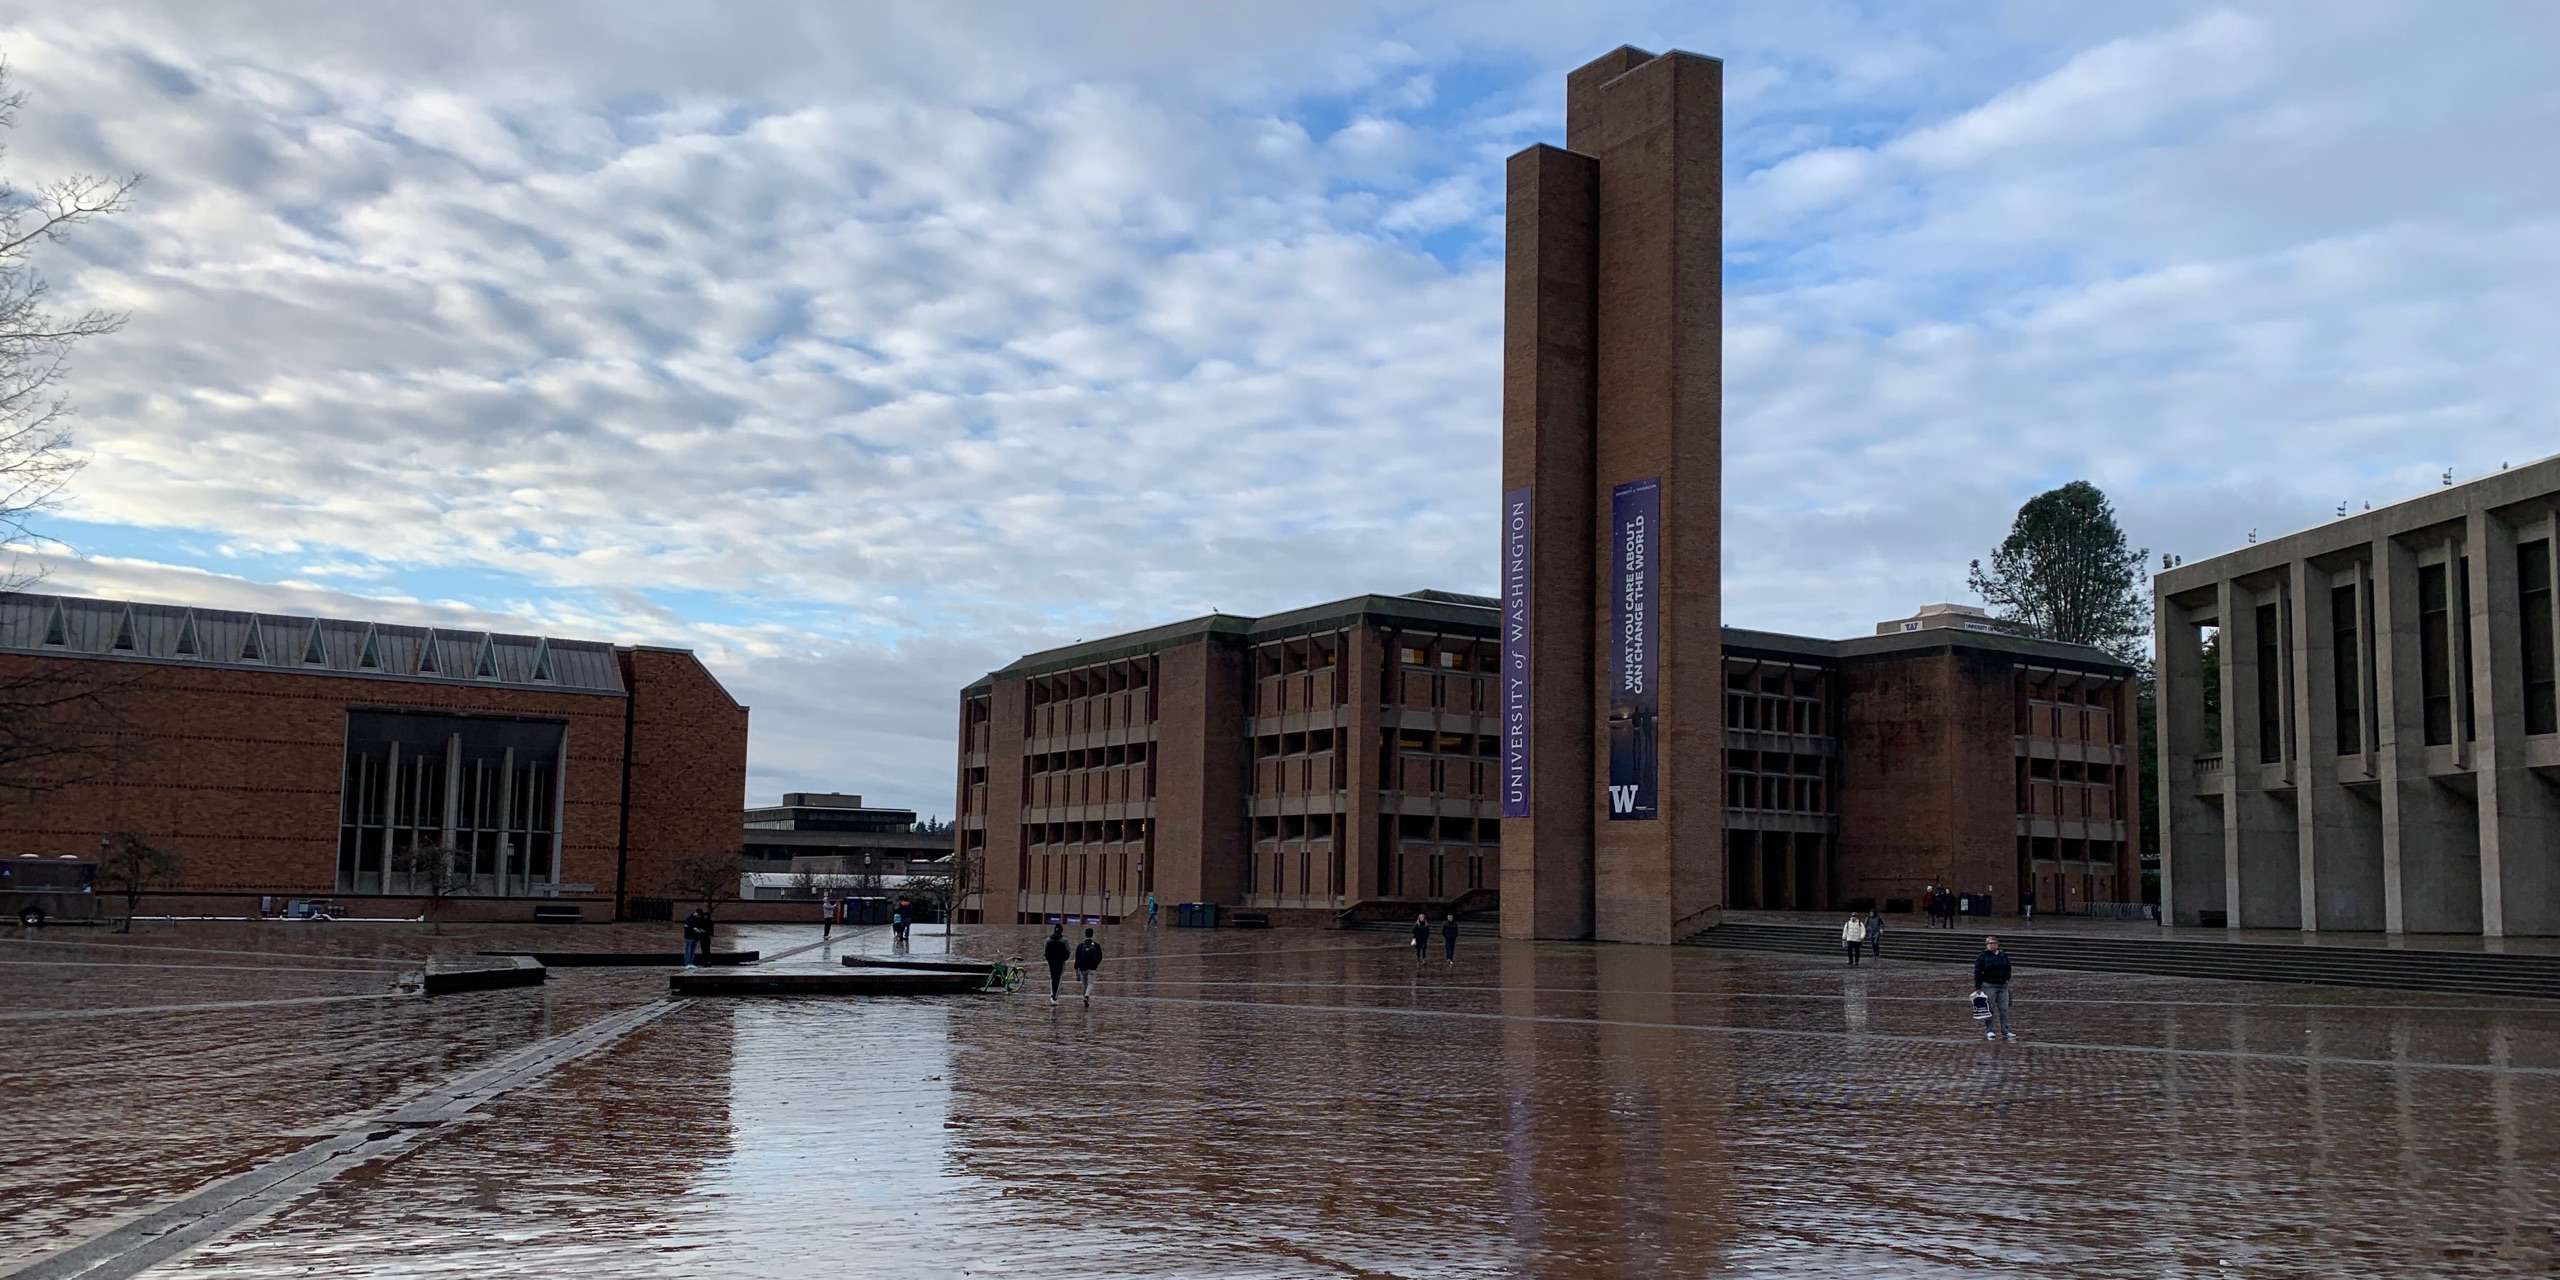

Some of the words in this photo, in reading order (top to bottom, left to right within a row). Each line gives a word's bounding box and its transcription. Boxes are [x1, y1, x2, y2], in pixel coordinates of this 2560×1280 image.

[1626, 522, 1635, 571] ABOUT
[1511, 502, 1524, 642] WASHINGTON
[1635, 571, 1644, 601] THE
[1625, 573, 1634, 611] CARE
[1625, 613, 1634, 645] YOU
[1634, 602, 1643, 662] CHANGE
[1511, 650, 1526, 669] of
[1625, 646, 1634, 690] WHAT
[1634, 664, 1643, 694] CAN
[1511, 678, 1523, 803] UNIVERSITY
[1609, 785, 1638, 813] W
